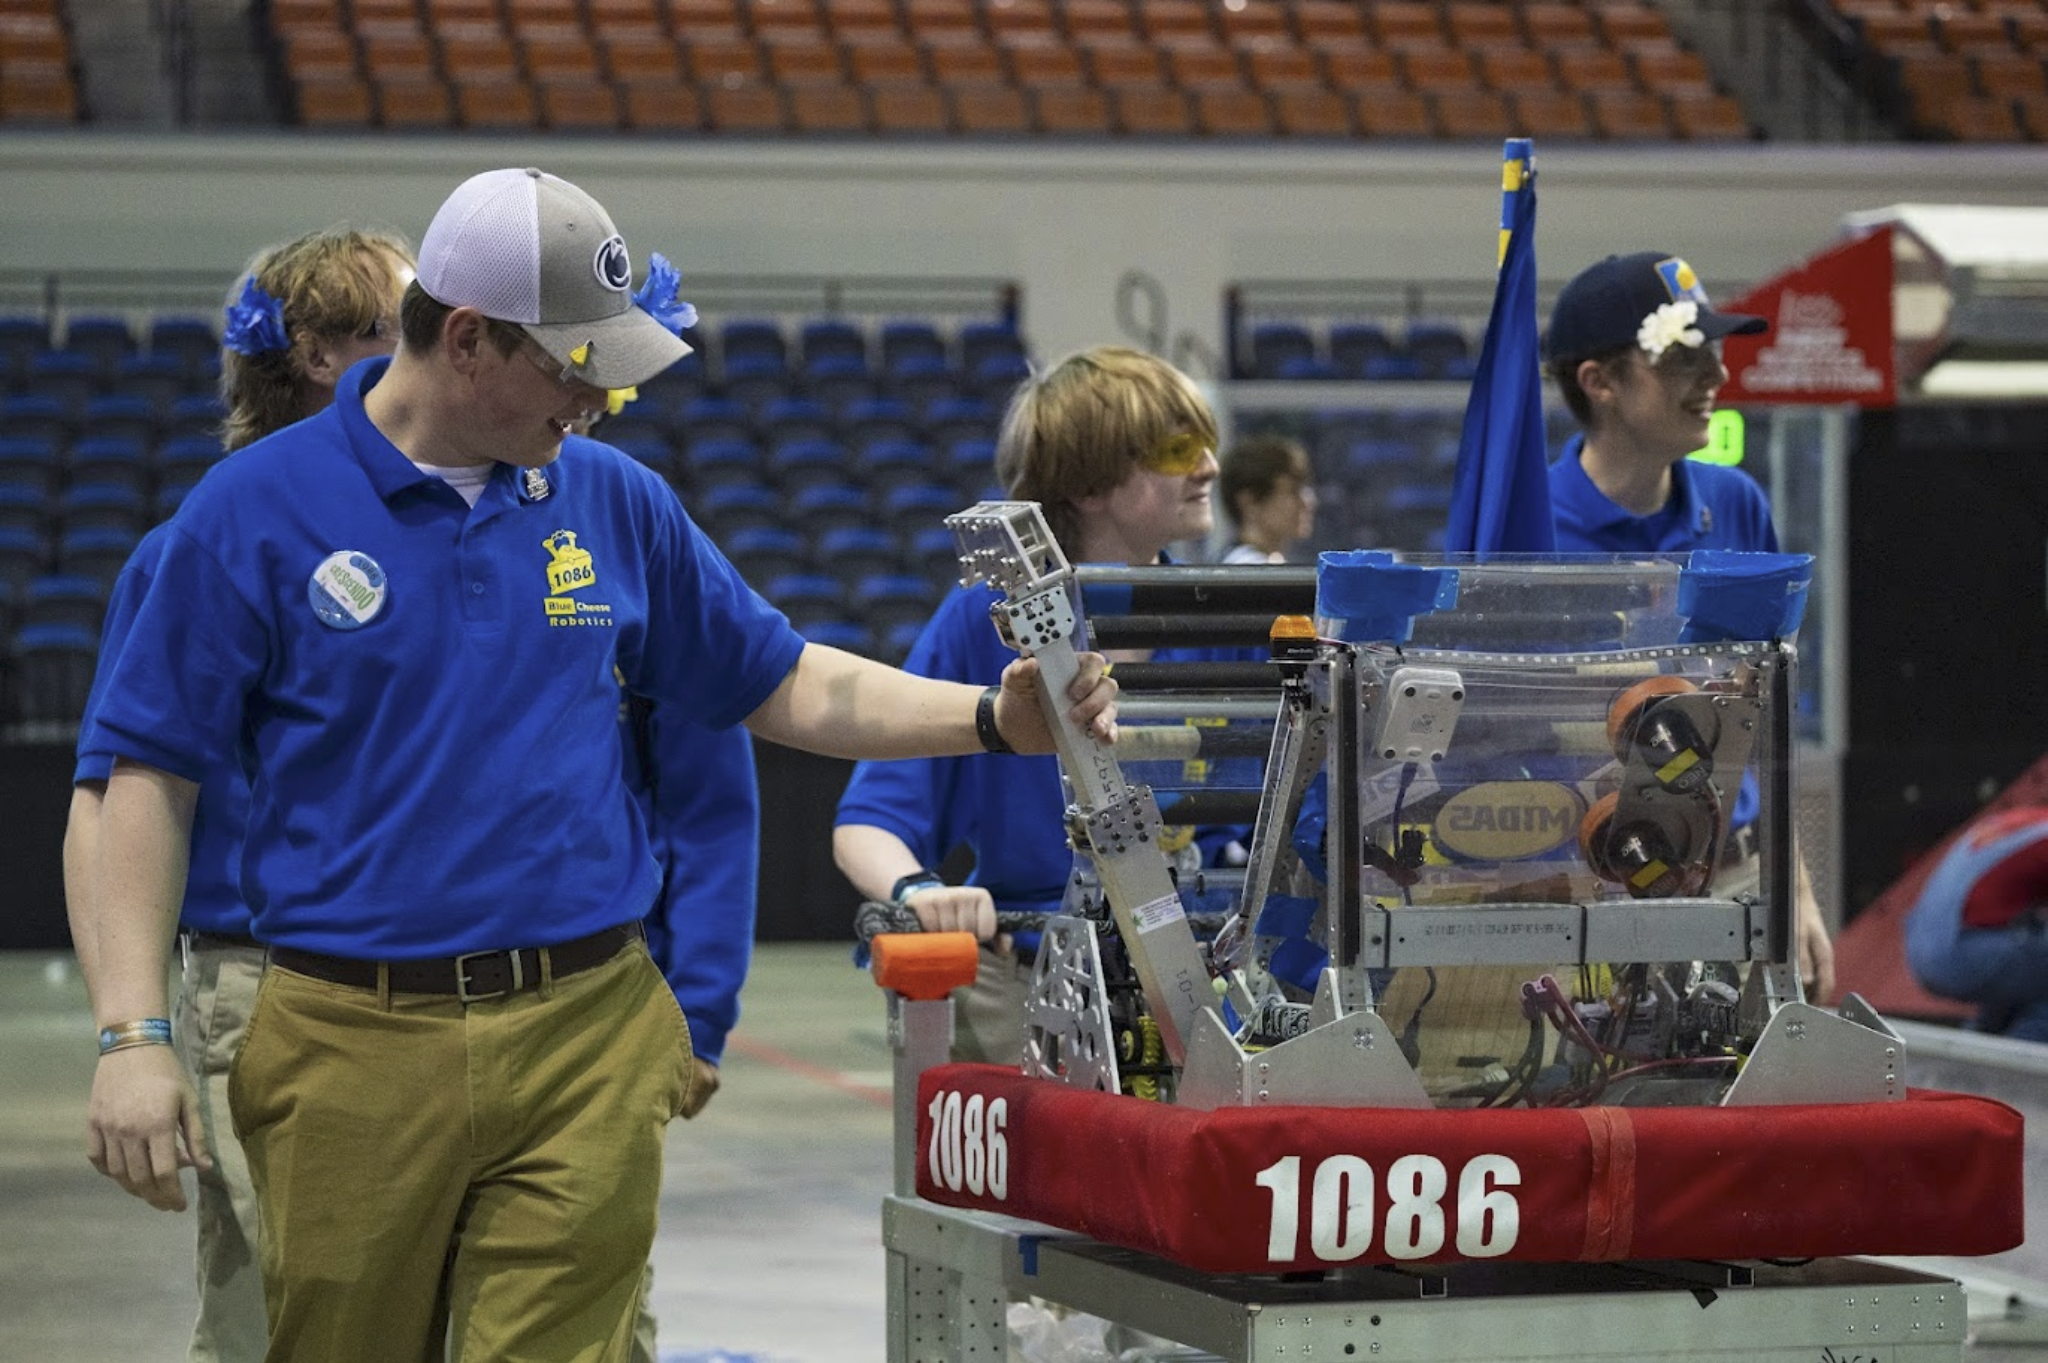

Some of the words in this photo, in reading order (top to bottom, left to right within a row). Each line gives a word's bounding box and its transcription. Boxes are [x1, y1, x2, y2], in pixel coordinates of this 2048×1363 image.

[330, 564, 376, 610] CRESCENDO
[554, 565, 591, 587] 1086
[549, 601, 572, 610] Blue
[576, 602, 611, 612] Cheese
[549, 617, 614, 627] Robotics
[929, 1089, 1008, 1201] 1086
[1255, 1153, 1522, 1262] 1086
